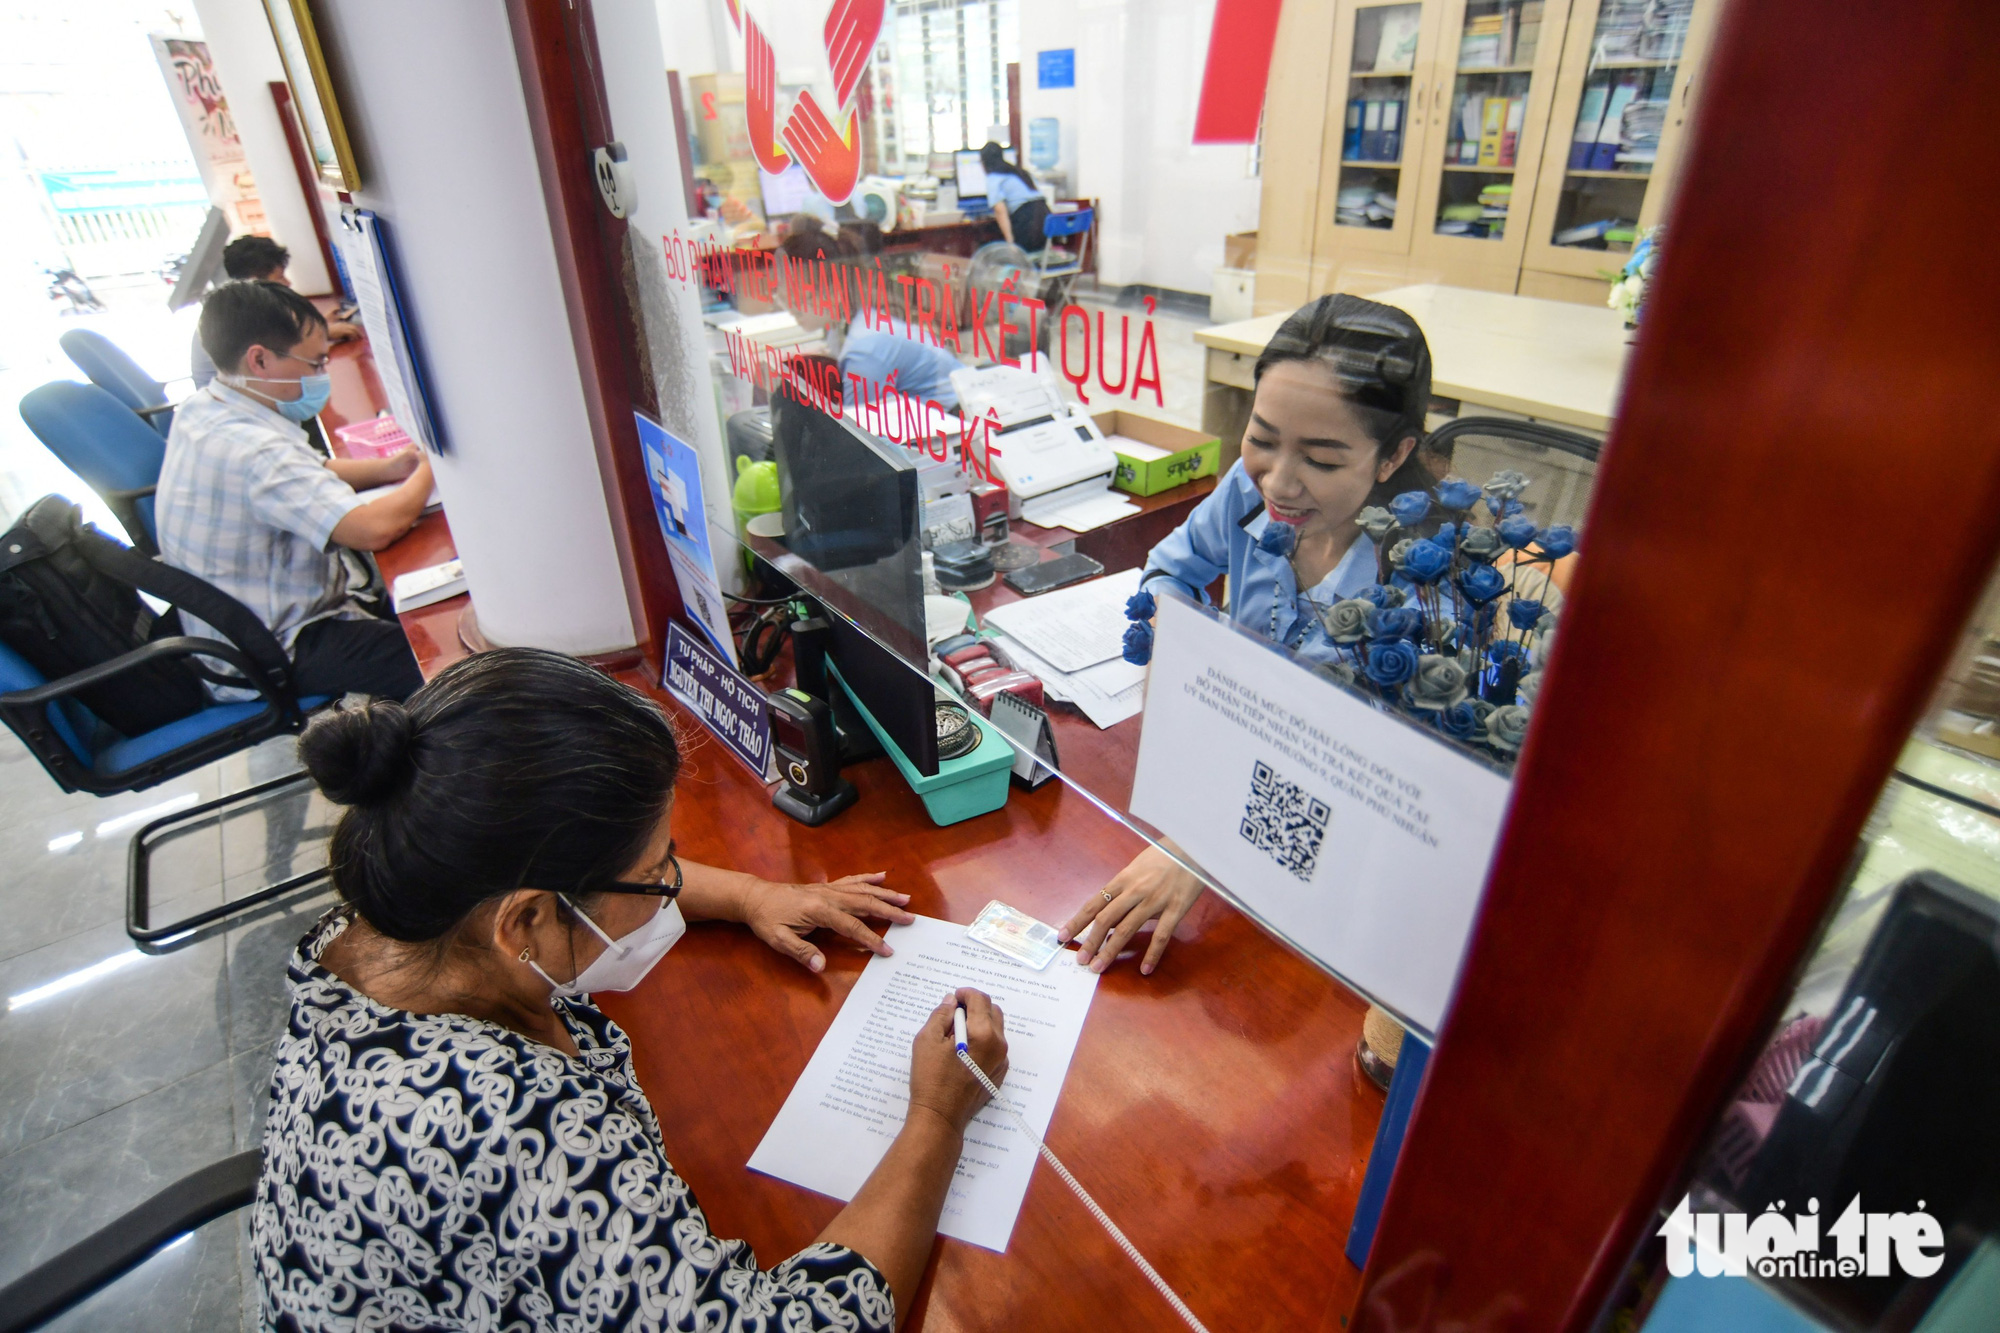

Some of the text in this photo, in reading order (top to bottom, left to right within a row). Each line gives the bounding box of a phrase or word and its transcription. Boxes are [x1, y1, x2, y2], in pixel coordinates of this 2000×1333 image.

[662, 228, 1164, 408] BỘ PHẬN TIẾP NHẬN VÀ TRẢ KẾT QUẢ
[724, 326, 1006, 489] VĂN PHÒNG THỐNG KÊ
[679, 639, 691, 658] TƯ
[690, 649, 715, 677] PHÁP
[721, 674, 735, 697] HỘ
[737, 688, 760, 716] TỊCH
[700, 684, 715, 719] THỊ
[714, 700, 738, 736] NGỌC
[738, 719, 763, 759] THẢO
